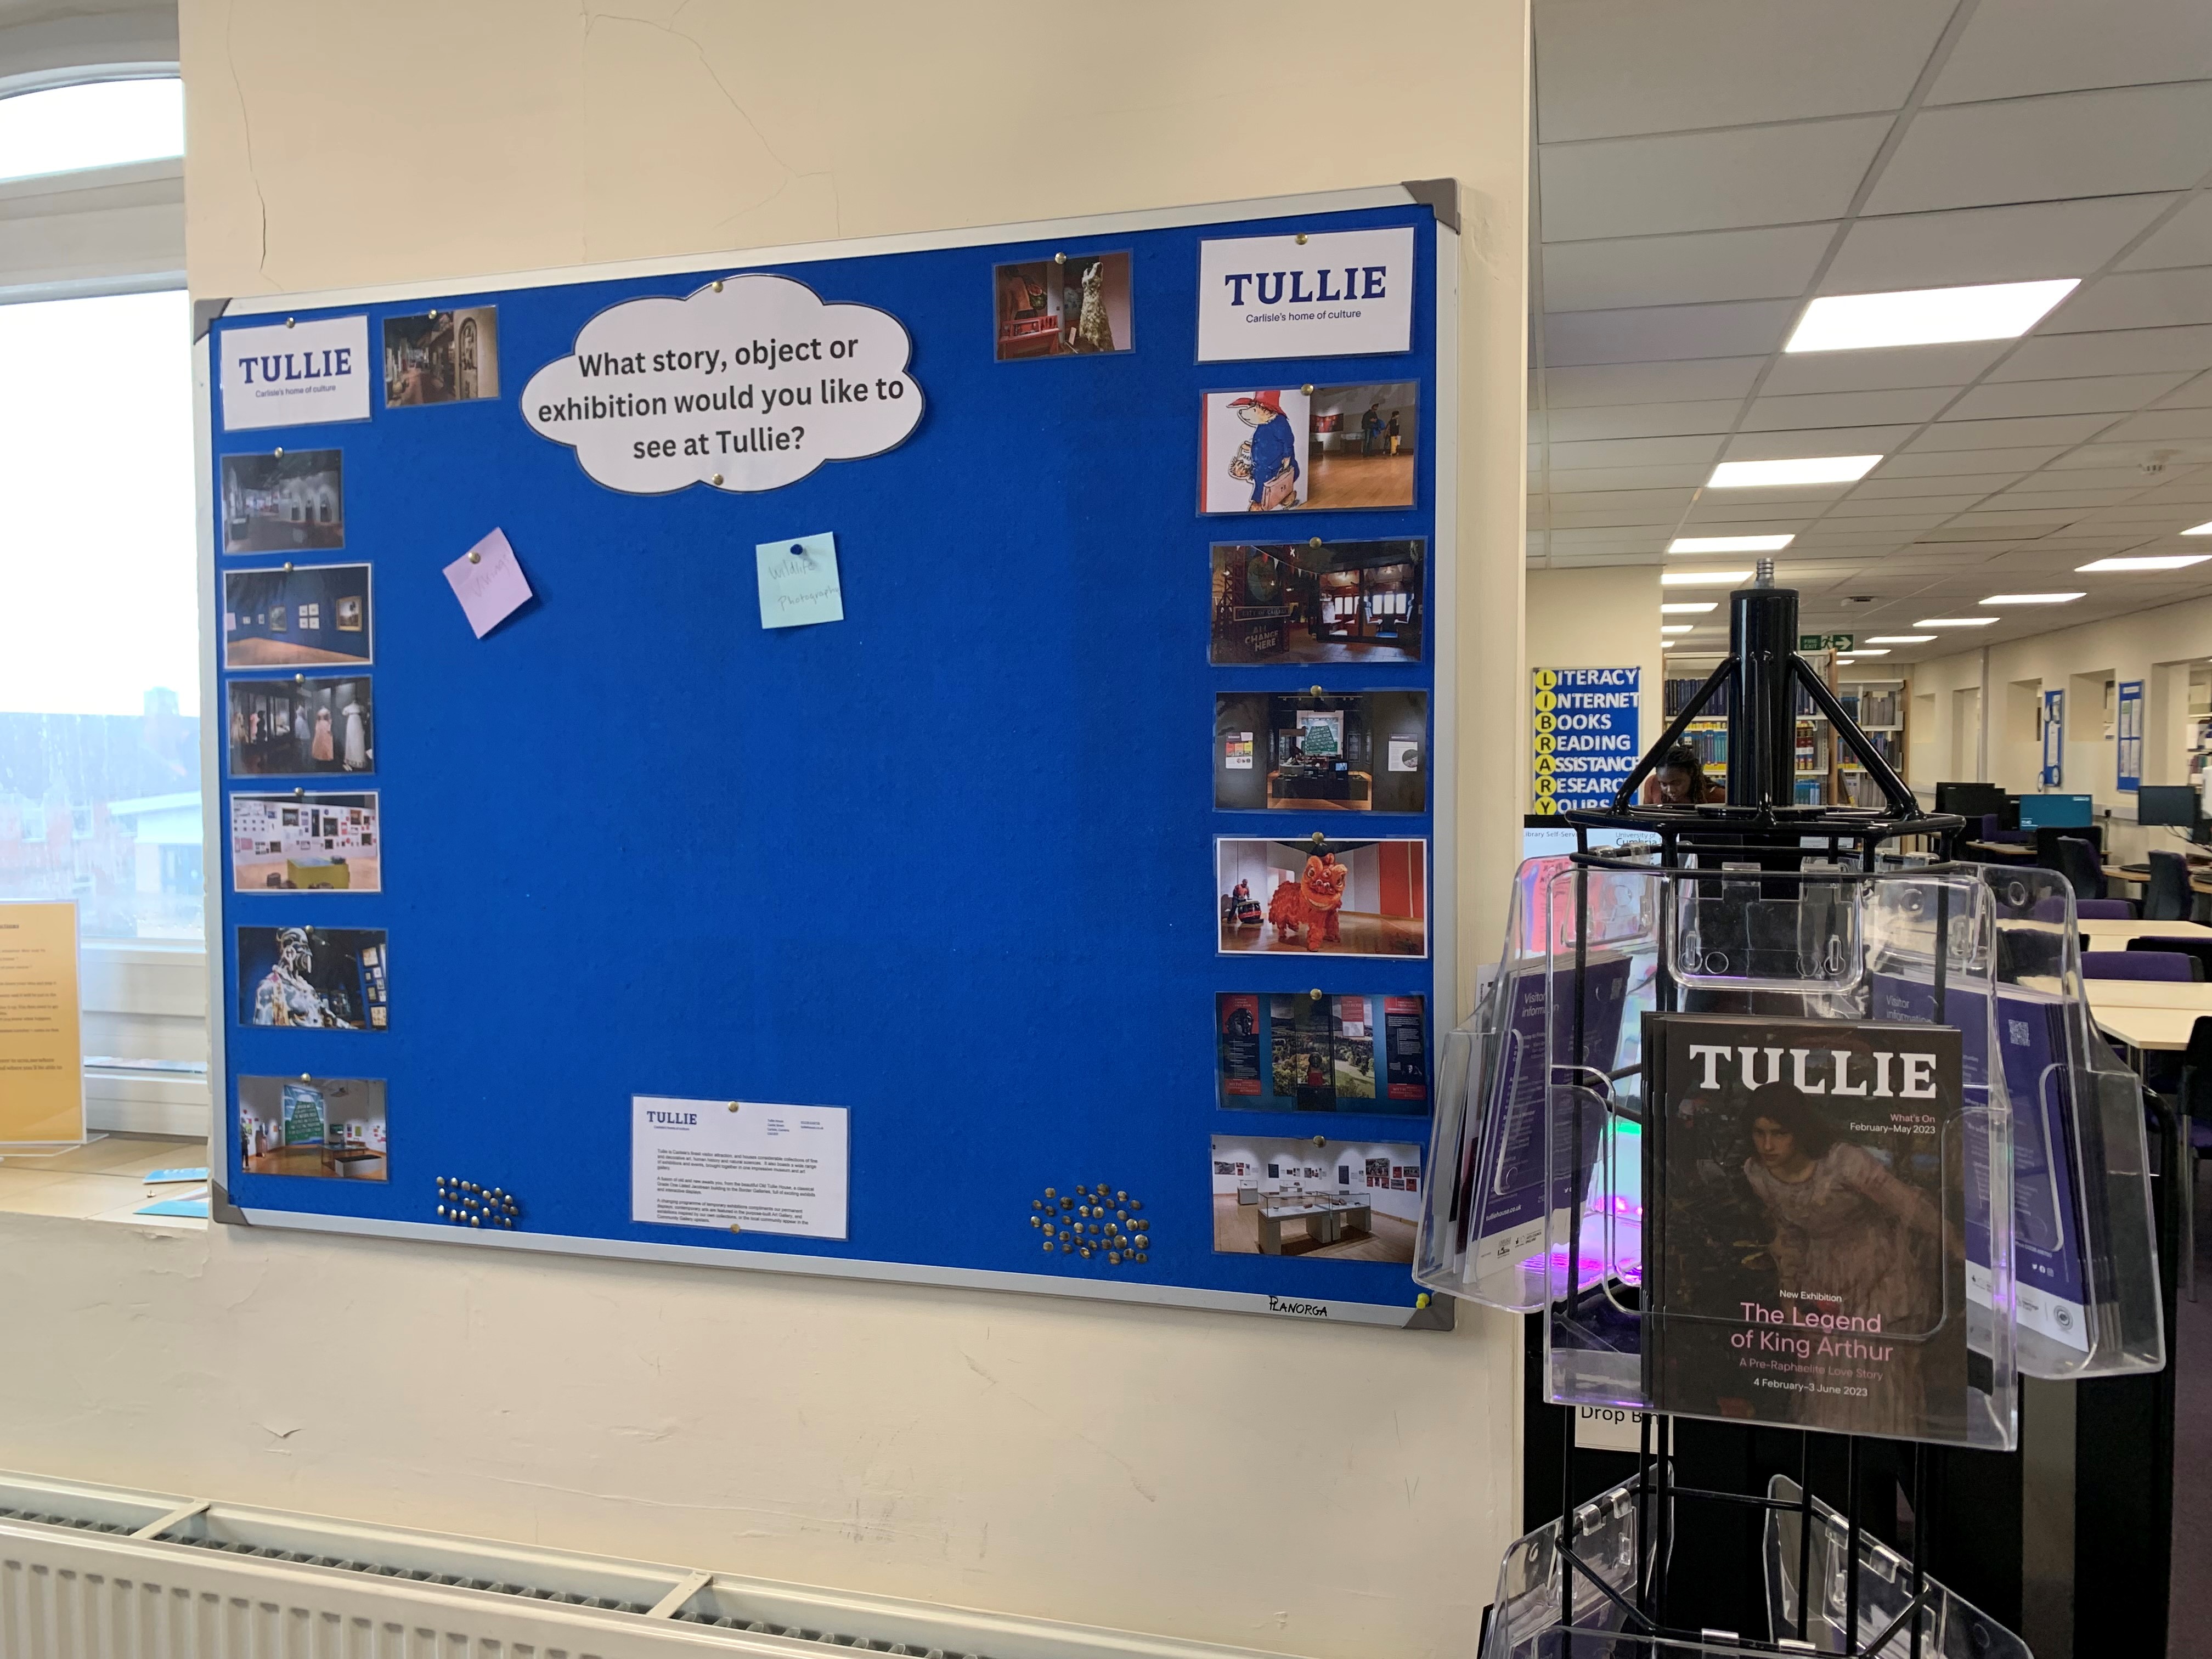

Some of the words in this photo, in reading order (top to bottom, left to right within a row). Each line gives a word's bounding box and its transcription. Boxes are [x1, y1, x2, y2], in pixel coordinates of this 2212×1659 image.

[1224, 266, 1386, 306] TULLIE
[1245, 312, 1286, 323] Carlisle's
[1289, 312, 1314, 321] home
[1317, 311, 1326, 320] of
[1328, 310, 1361, 319] culture
[578, 351, 646, 377] What
[653, 347, 727, 375] story,
[735, 337, 822, 370] object
[830, 338, 859, 359] or
[239, 348, 351, 384] TULLIE
[256, 388, 284, 398] Carlisle's
[538, 393, 667, 422] exhibition
[674, 384, 754, 414] would
[761, 386, 812, 414] you
[821, 379, 868, 404] like
[876, 377, 904, 400] to
[633, 437, 676, 459] see
[684, 433, 709, 455] at
[716, 426, 805, 454] Tullie?
[1255, 638, 1276, 652] HERE
[1543, 670, 1638, 686] LITERACY
[1544, 692, 1639, 708] INTERNET
[1541, 714, 1612, 731] BOOKS
[1540, 735, 1630, 751] READING
[1541, 778, 1628, 793] RESEARC
[1886, 995, 1909, 1008] Visitor
[1522, 1004, 1559, 1017] informn
[1690, 1045, 1936, 1098] TULLIE
[647, 1111, 697, 1125] TULLIE
[1891, 1113, 1920, 1122] What's
[1922, 1115, 1935, 1123] On
[1914, 1125, 1936, 1134] 2023
[1780, 1290, 1798, 1299] New
[1801, 1291, 1842, 1302] Exhibition
[1269, 1295, 1327, 1317] PLANORGA
[1740, 1302, 1784, 1324] The
[1793, 1307, 1881, 1333] Legend
[1731, 1330, 1754, 1348] of
[1760, 1331, 1810, 1358] King
[1817, 1336, 1893, 1361] Arthur
[1740, 1358, 1747, 1367] A
[1750, 1359, 1825, 1375] Pre-Raphaelite
[1829, 1366, 1853, 1378] Love
[1856, 1369, 1883, 1381] Story
[1817, 1385, 1841, 1394] June
[1844, 1386, 1868, 1396] 2023
[1582, 1406, 1625, 1425] Drop
[1632, 1412, 1658, 1425] Bn
